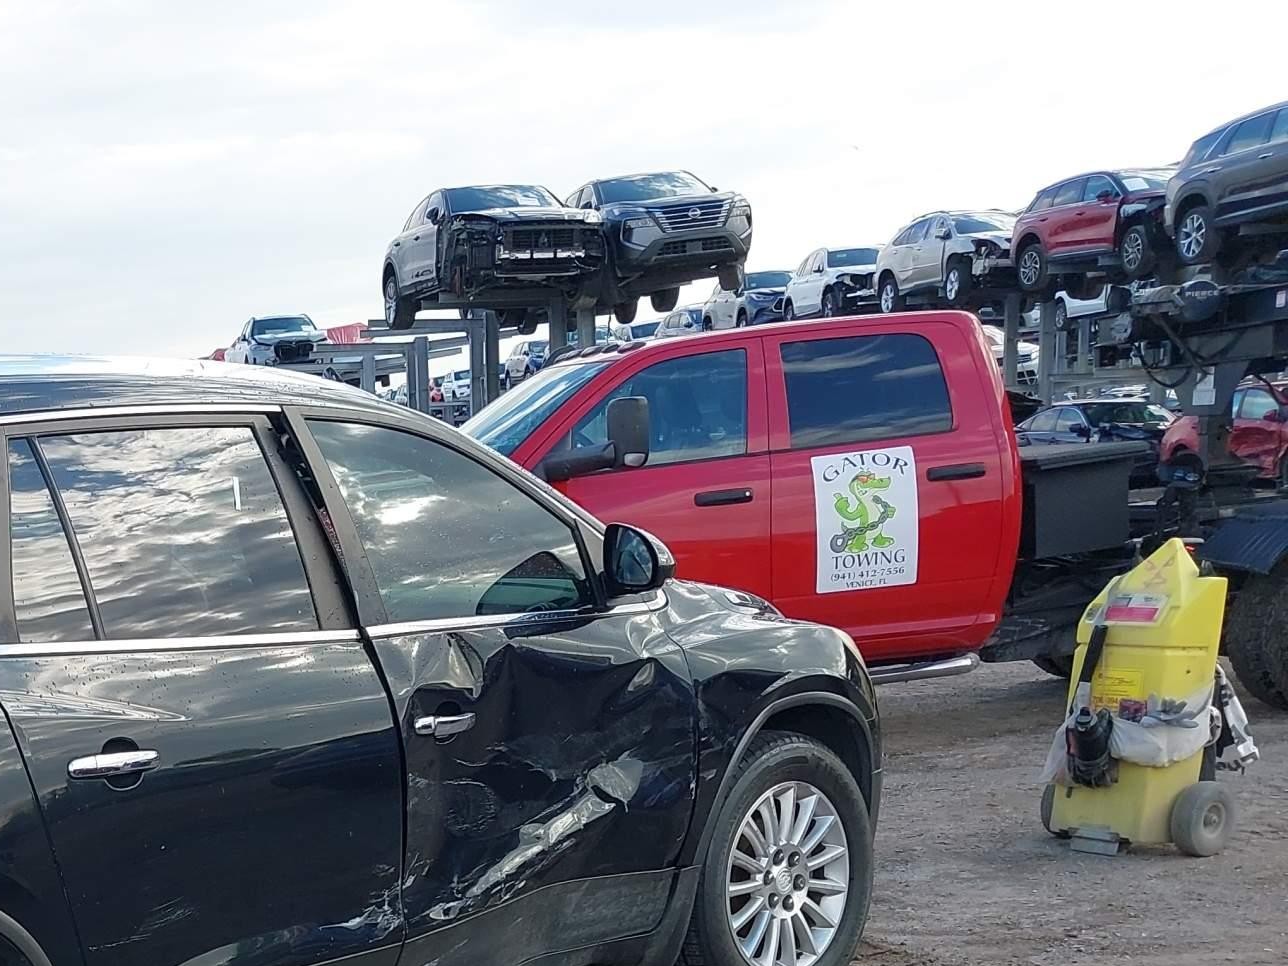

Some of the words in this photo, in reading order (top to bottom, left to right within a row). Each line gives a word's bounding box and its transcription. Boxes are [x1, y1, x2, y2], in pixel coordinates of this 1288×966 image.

[822, 452, 909, 483] GATOR
[831, 549, 905, 570] TOWING
[830, 572, 856, 581] (941)
